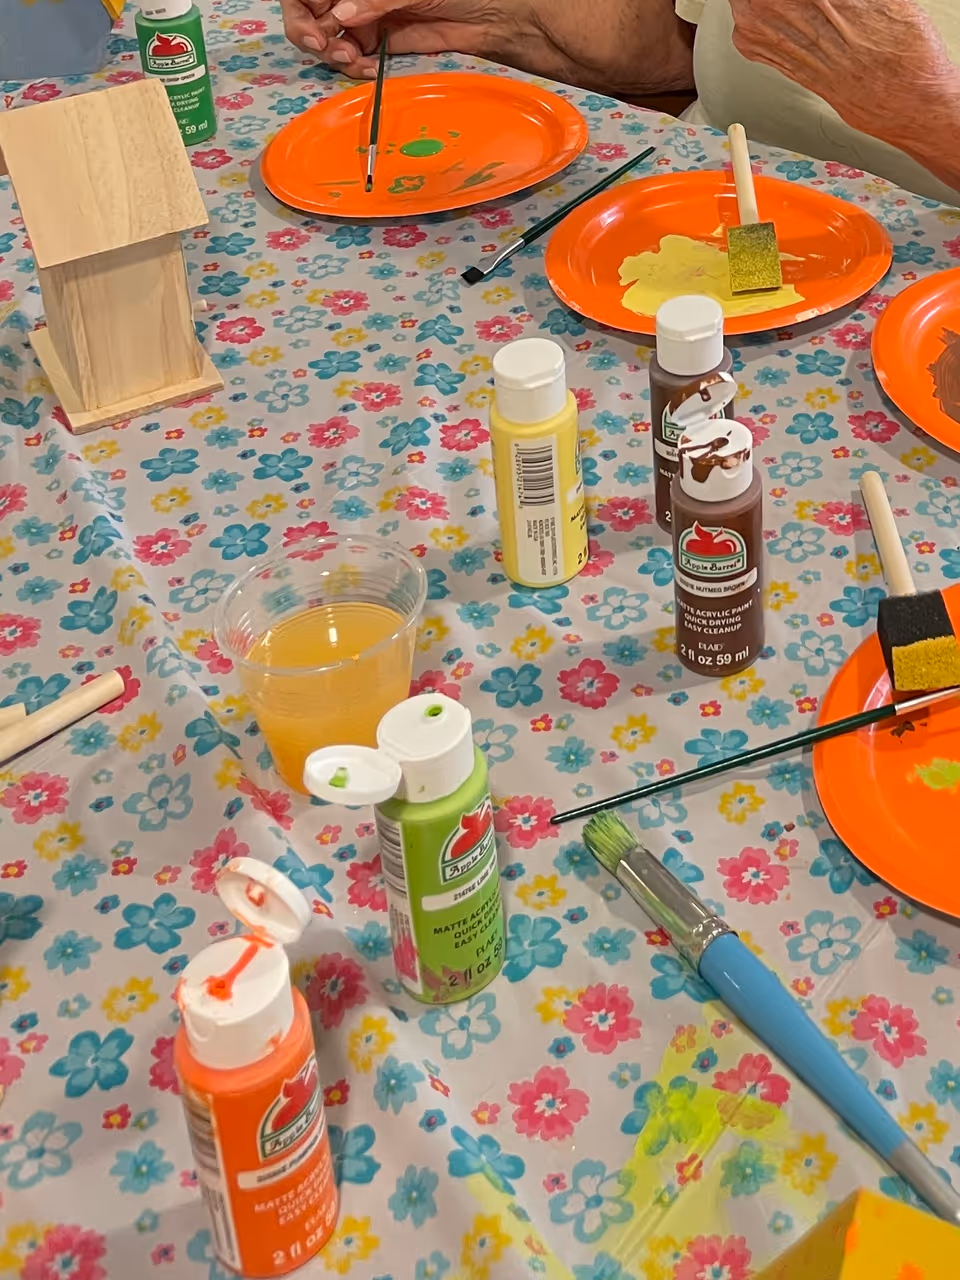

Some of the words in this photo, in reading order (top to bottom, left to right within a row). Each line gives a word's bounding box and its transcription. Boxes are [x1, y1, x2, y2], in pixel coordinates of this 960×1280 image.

[170, 92, 190, 101] CRYLIC
[185, 125, 196, 135] 59
[684, 558, 708, 571] Apple
[695, 609, 731, 618] ACRYLIC
[731, 599, 753, 615] PAINT
[684, 612, 708, 626] QUICK
[709, 615, 741, 626] DRYING
[684, 620, 702, 633] EASY
[703, 623, 742, 634] CLEANUP
[680, 644, 687, 656] 2
[688, 649, 695, 661] fl
[697, 655, 713, 666] oz
[716, 653, 732, 666] 59
[735, 645, 749, 662] ml
[449, 854, 478, 878] Apple
[433, 917, 467, 935] MATTE
[454, 918, 483, 939] QUICK
[454, 931, 478, 949] EASY
[448, 974, 459, 987] 2
[464, 966, 472, 983] fl
[476, 956, 492, 974] oz
[254, 1189, 295, 1213] MATTE
[272, 1250, 285, 1265] 2
[306, 1226, 323, 1248] oz
